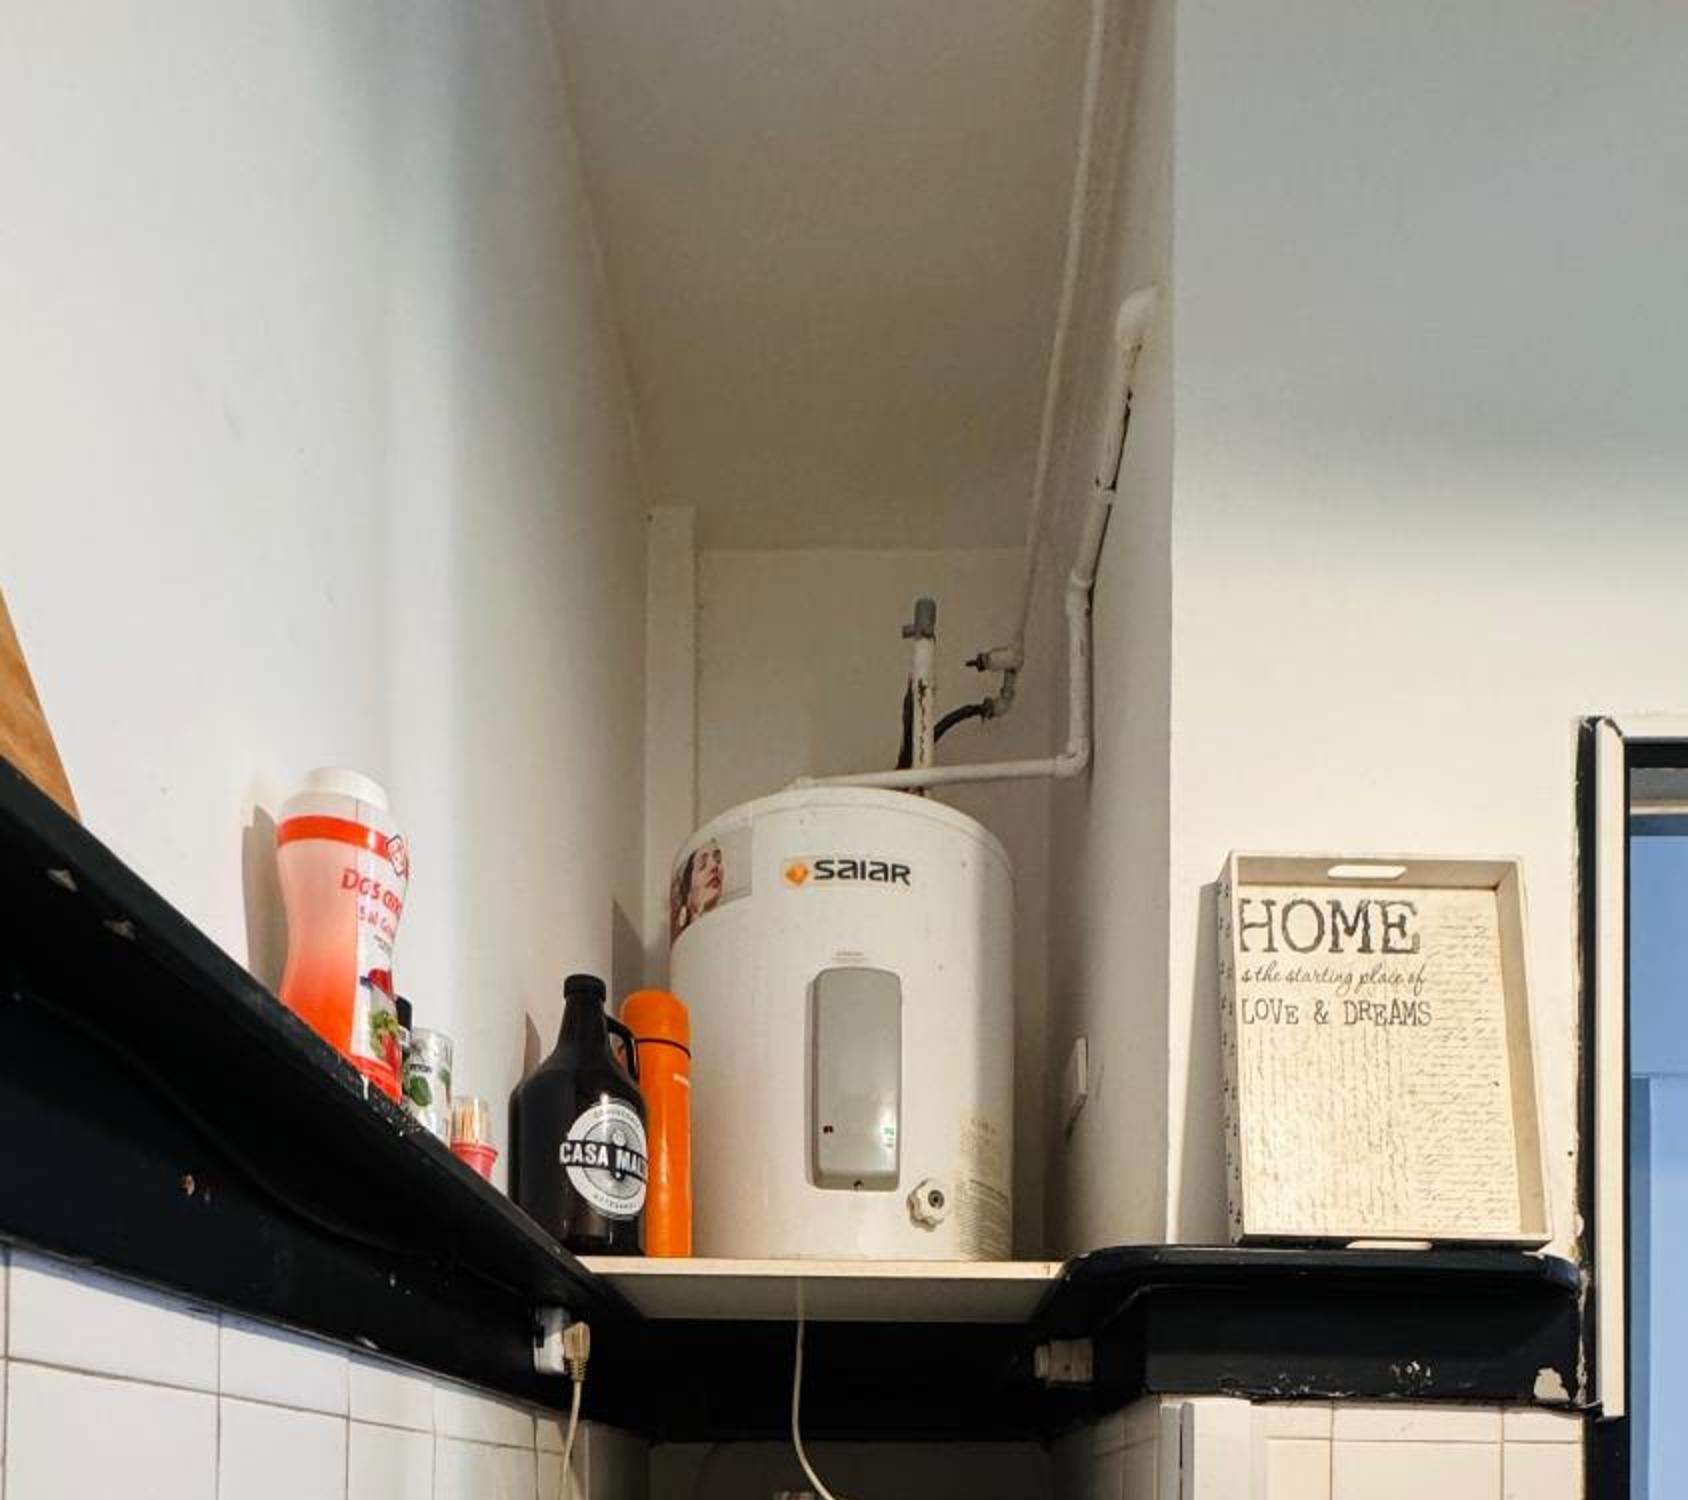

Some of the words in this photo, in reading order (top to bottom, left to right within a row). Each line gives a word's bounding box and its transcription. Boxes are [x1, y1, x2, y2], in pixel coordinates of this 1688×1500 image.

[1239, 898, 1420, 954] HOME
[1254, 959, 1281, 984] the
[1284, 968, 1353, 996] starting
[1354, 962, 1405, 994] place
[1406, 964, 1427, 997] of
[1241, 998, 1299, 1026] LOVE
[1313, 999, 1329, 1026] &
[1344, 998, 1432, 1027] DREAMS
[560, 1141, 609, 1167] CASA
